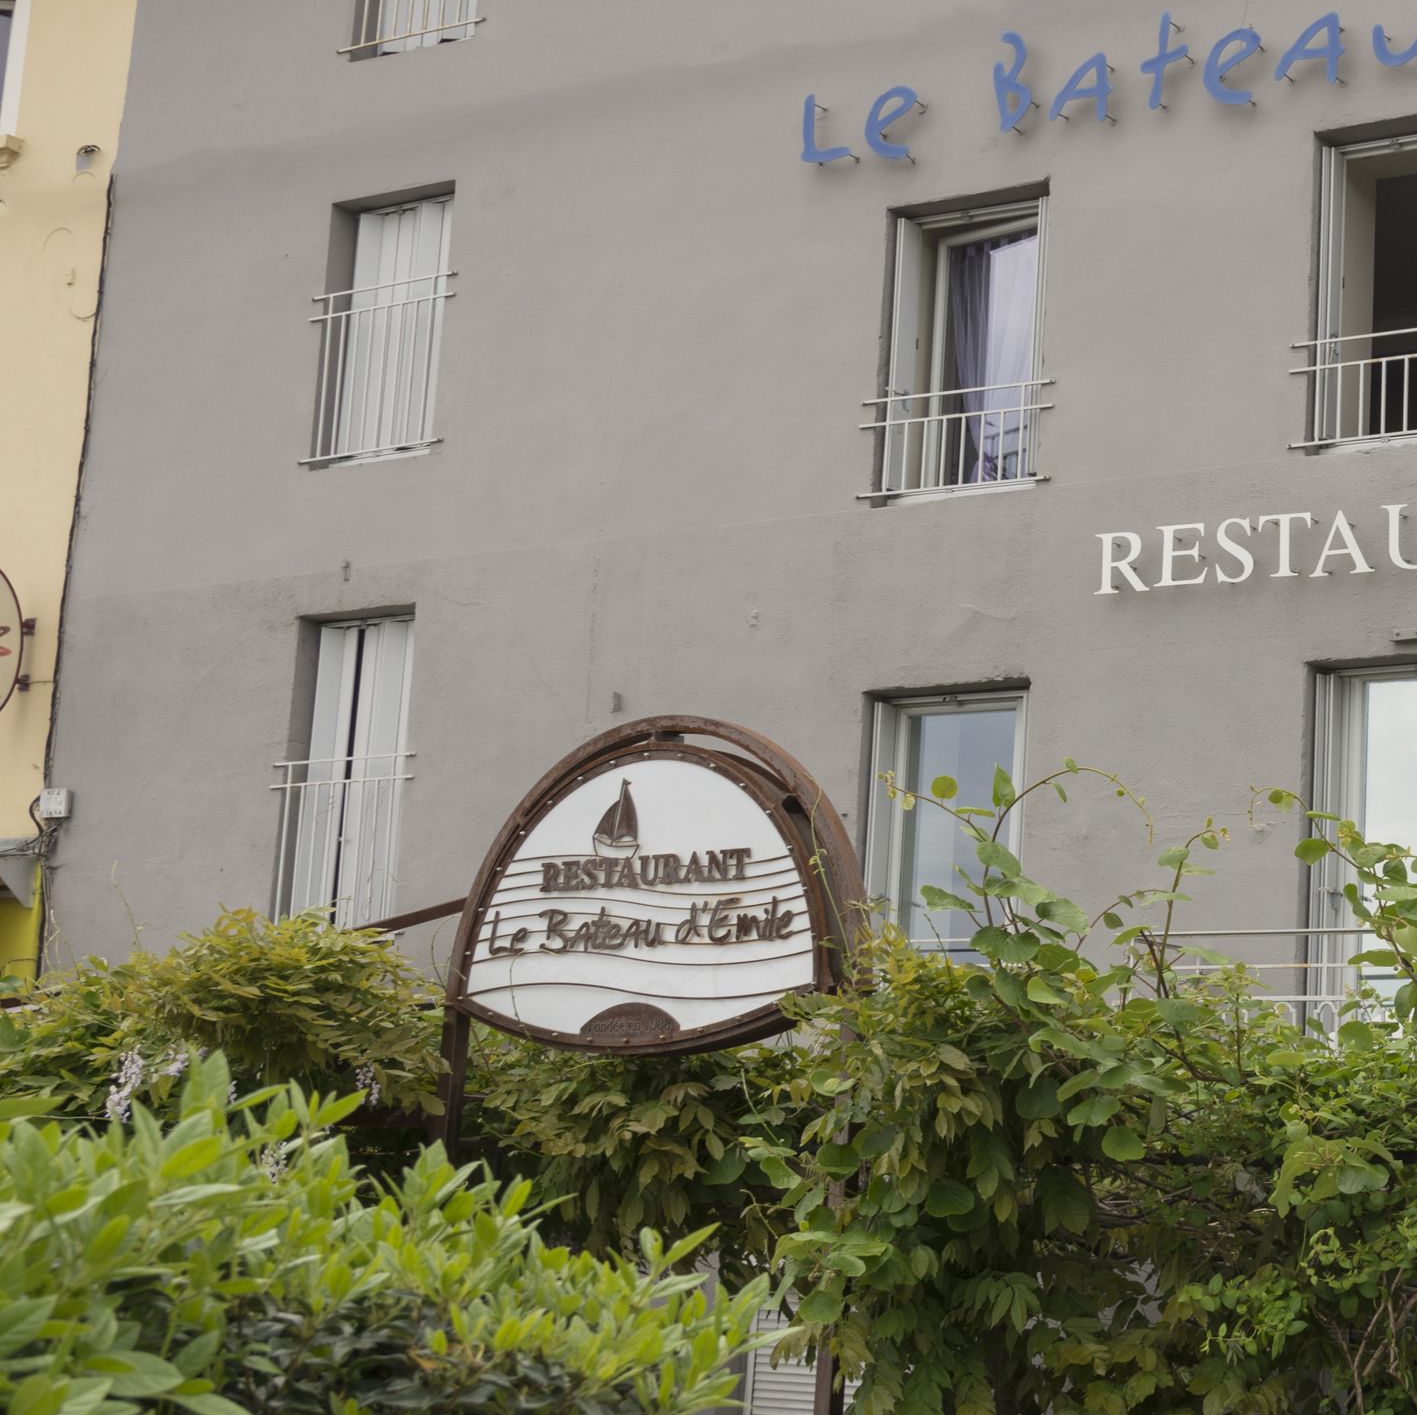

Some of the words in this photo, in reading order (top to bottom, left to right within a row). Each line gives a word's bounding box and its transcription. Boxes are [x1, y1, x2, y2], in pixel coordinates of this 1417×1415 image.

[801, 85, 917, 163] Le
[539, 847, 752, 893] RESTAURANT
[489, 910, 531, 956] Le
[674, 895, 795, 945] d'Emile
[587, 1018, 628, 1033] Fondée
[628, 1020, 641, 1032] en
[645, 1018, 671, 1032] 1988
